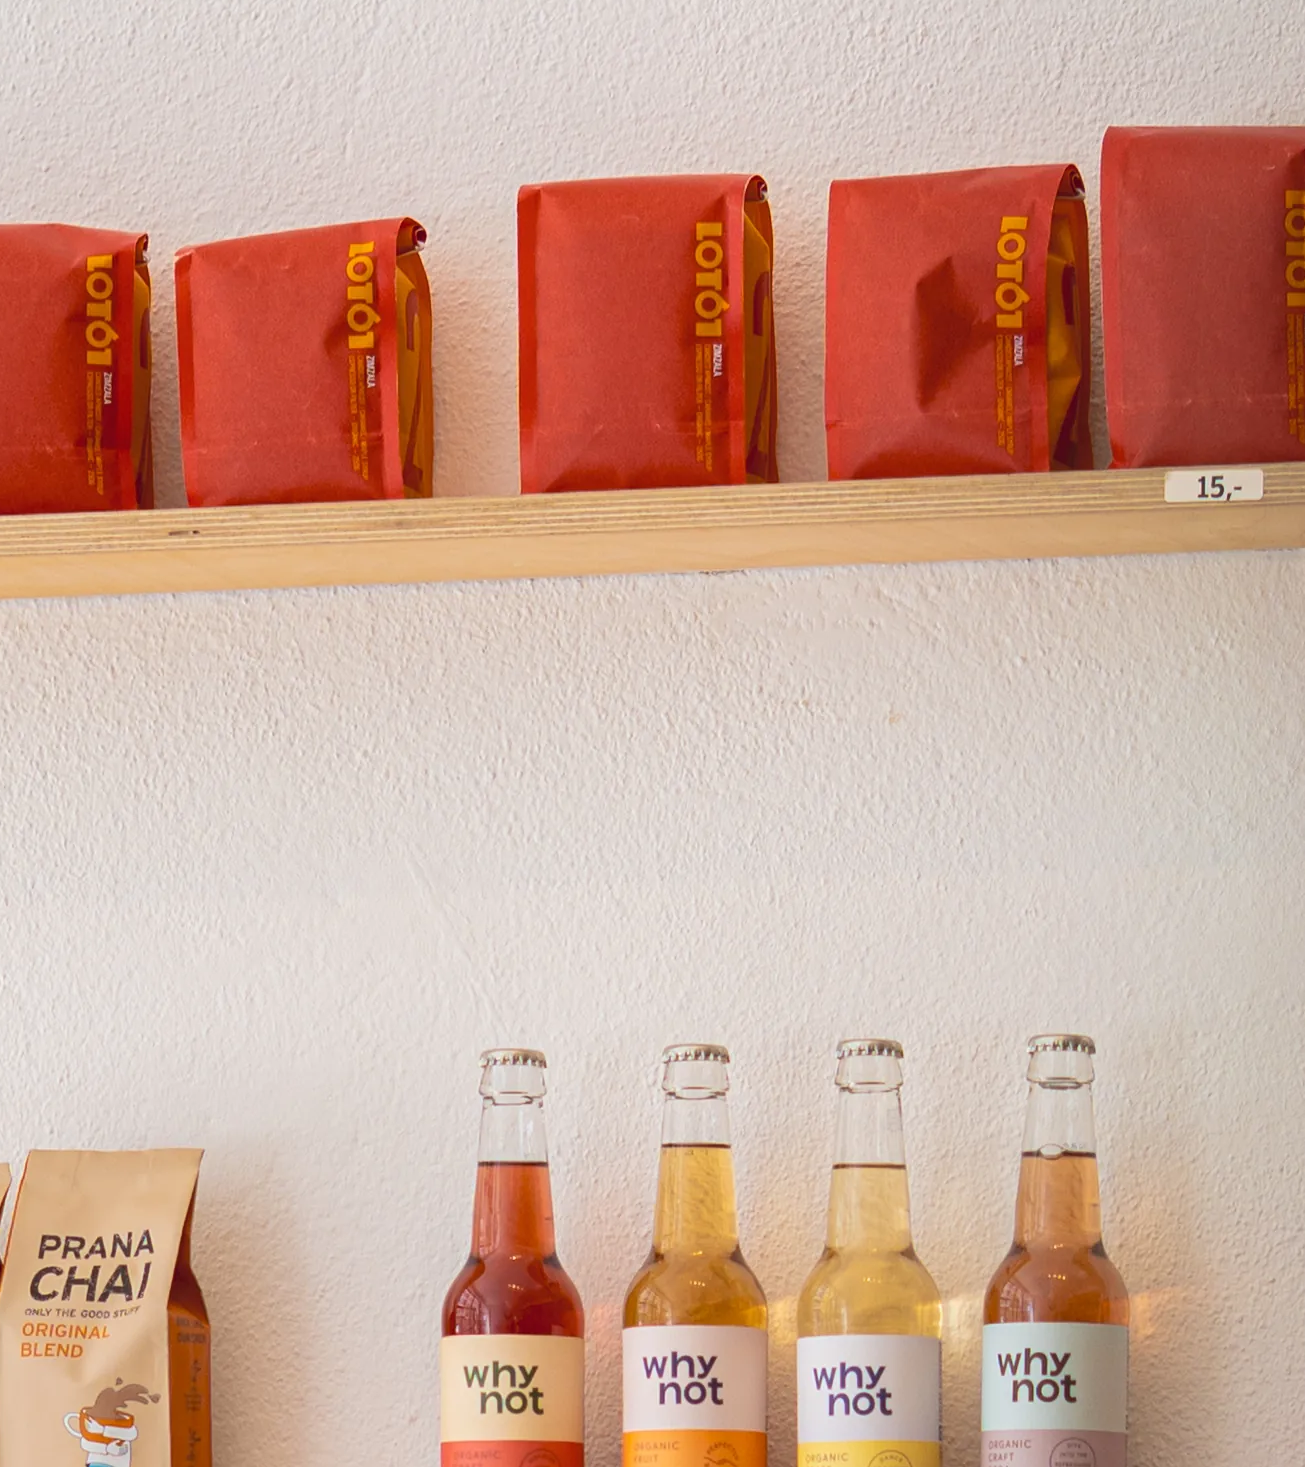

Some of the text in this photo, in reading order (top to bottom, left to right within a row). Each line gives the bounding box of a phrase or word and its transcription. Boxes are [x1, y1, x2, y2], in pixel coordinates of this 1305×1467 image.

[695, 222, 730, 337] LOT61
[995, 216, 1030, 328] LOT61
[346, 241, 381, 349] LOT61
[85, 254, 119, 365] LOT61
[1197, 475, 1243, 501] 15,-
[38, 1229, 154, 1259] PRANA
[29, 1261, 152, 1302] CHAI
[24, 1305, 141, 1318] ONLY THE GOOD STUFF
[22, 1322, 110, 1340] ORIGINAL
[20, 1342, 83, 1358] BLEND
[998, 1348, 1071, 1376] why
[463, 1361, 538, 1388] why
[643, 1351, 718, 1379] why
[813, 1362, 886, 1390] why
[480, 1388, 544, 1415] not
[659, 1378, 723, 1405] not
[828, 1388, 893, 1416] not
[1012, 1375, 1077, 1403] not
[634, 1441, 679, 1451] ORGANIC
[806, 1453, 849, 1463] ORGANIC
[988, 1440, 1032, 1450] ORGANIC
[988, 1453, 1014, 1462] CRAFT
